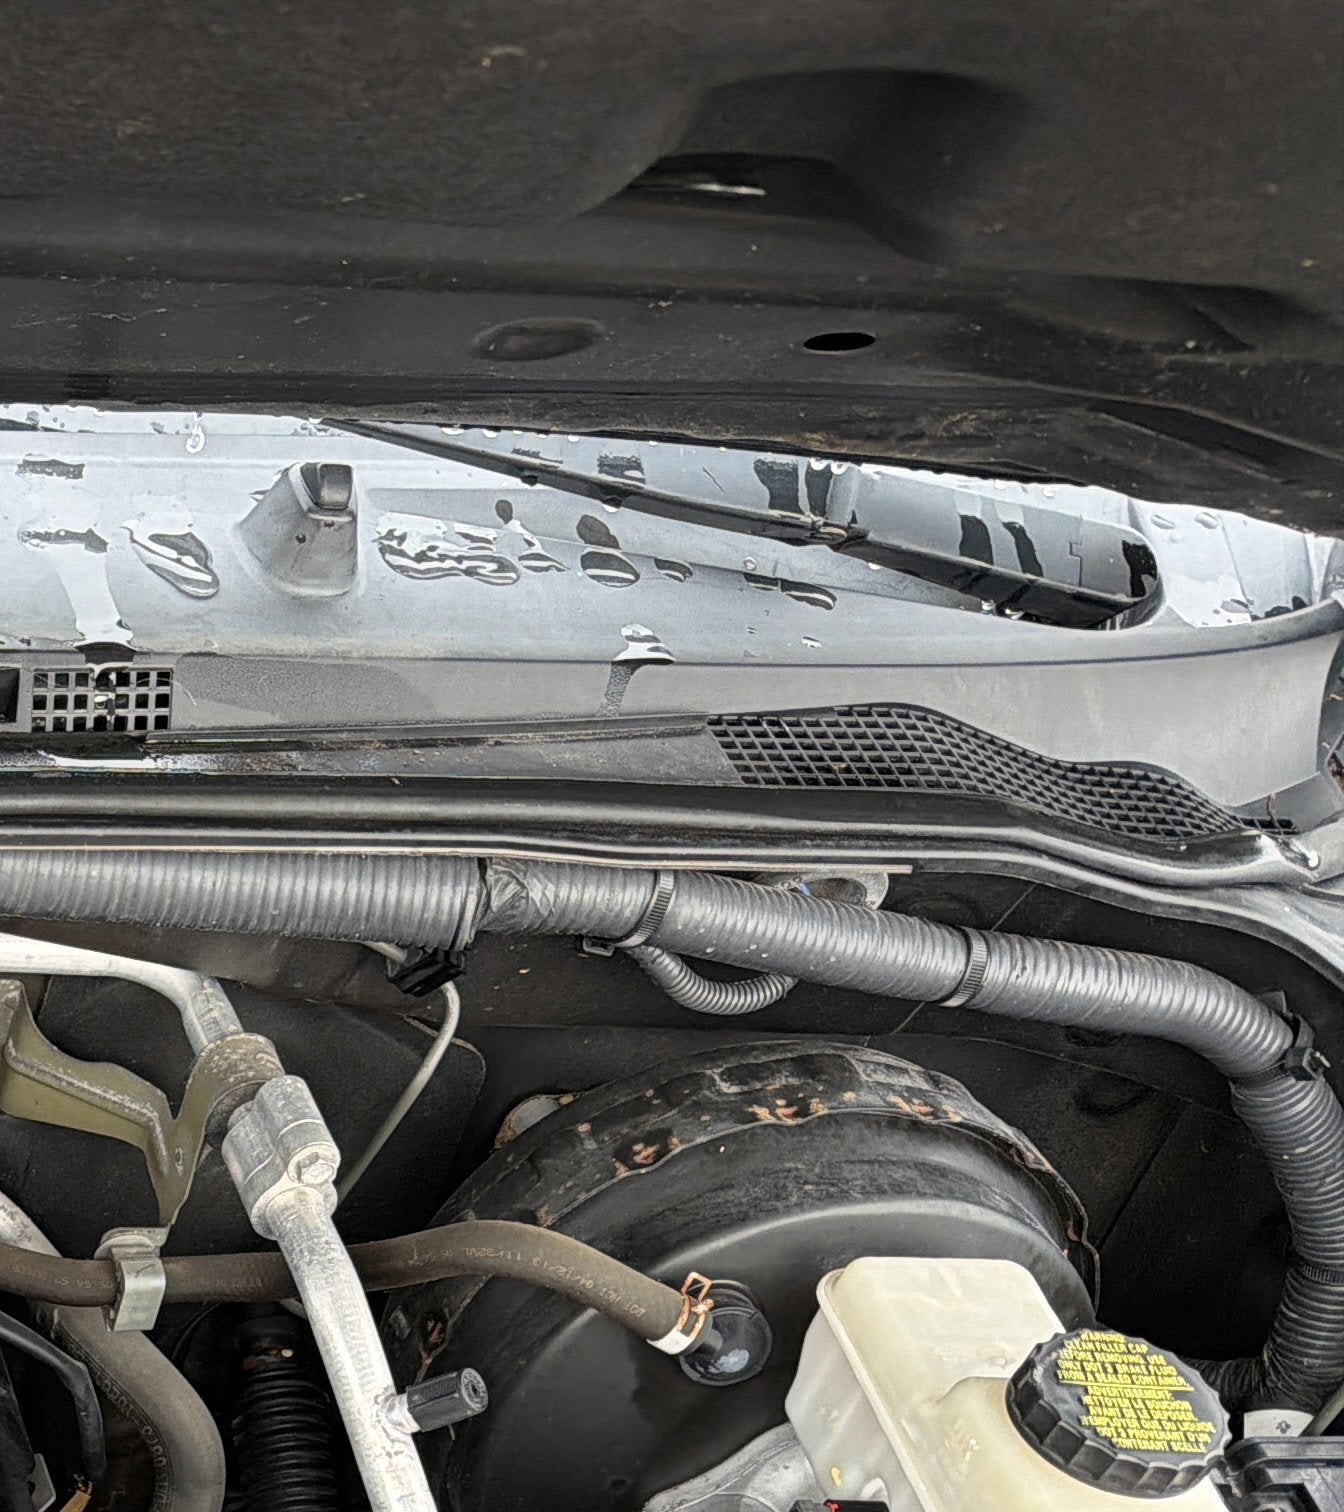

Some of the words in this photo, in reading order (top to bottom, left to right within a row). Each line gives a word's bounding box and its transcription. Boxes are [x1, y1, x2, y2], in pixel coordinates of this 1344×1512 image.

[1127, 1343, 1150, 1353] CAP
[1083, 1361, 1103, 1371] DOT
[1105, 1362, 1114, 1372] 3
[1115, 1363, 1149, 1374] BRAKE
[1149, 1365, 1178, 1374] FLUID
[1085, 1371, 1095, 1381] A
